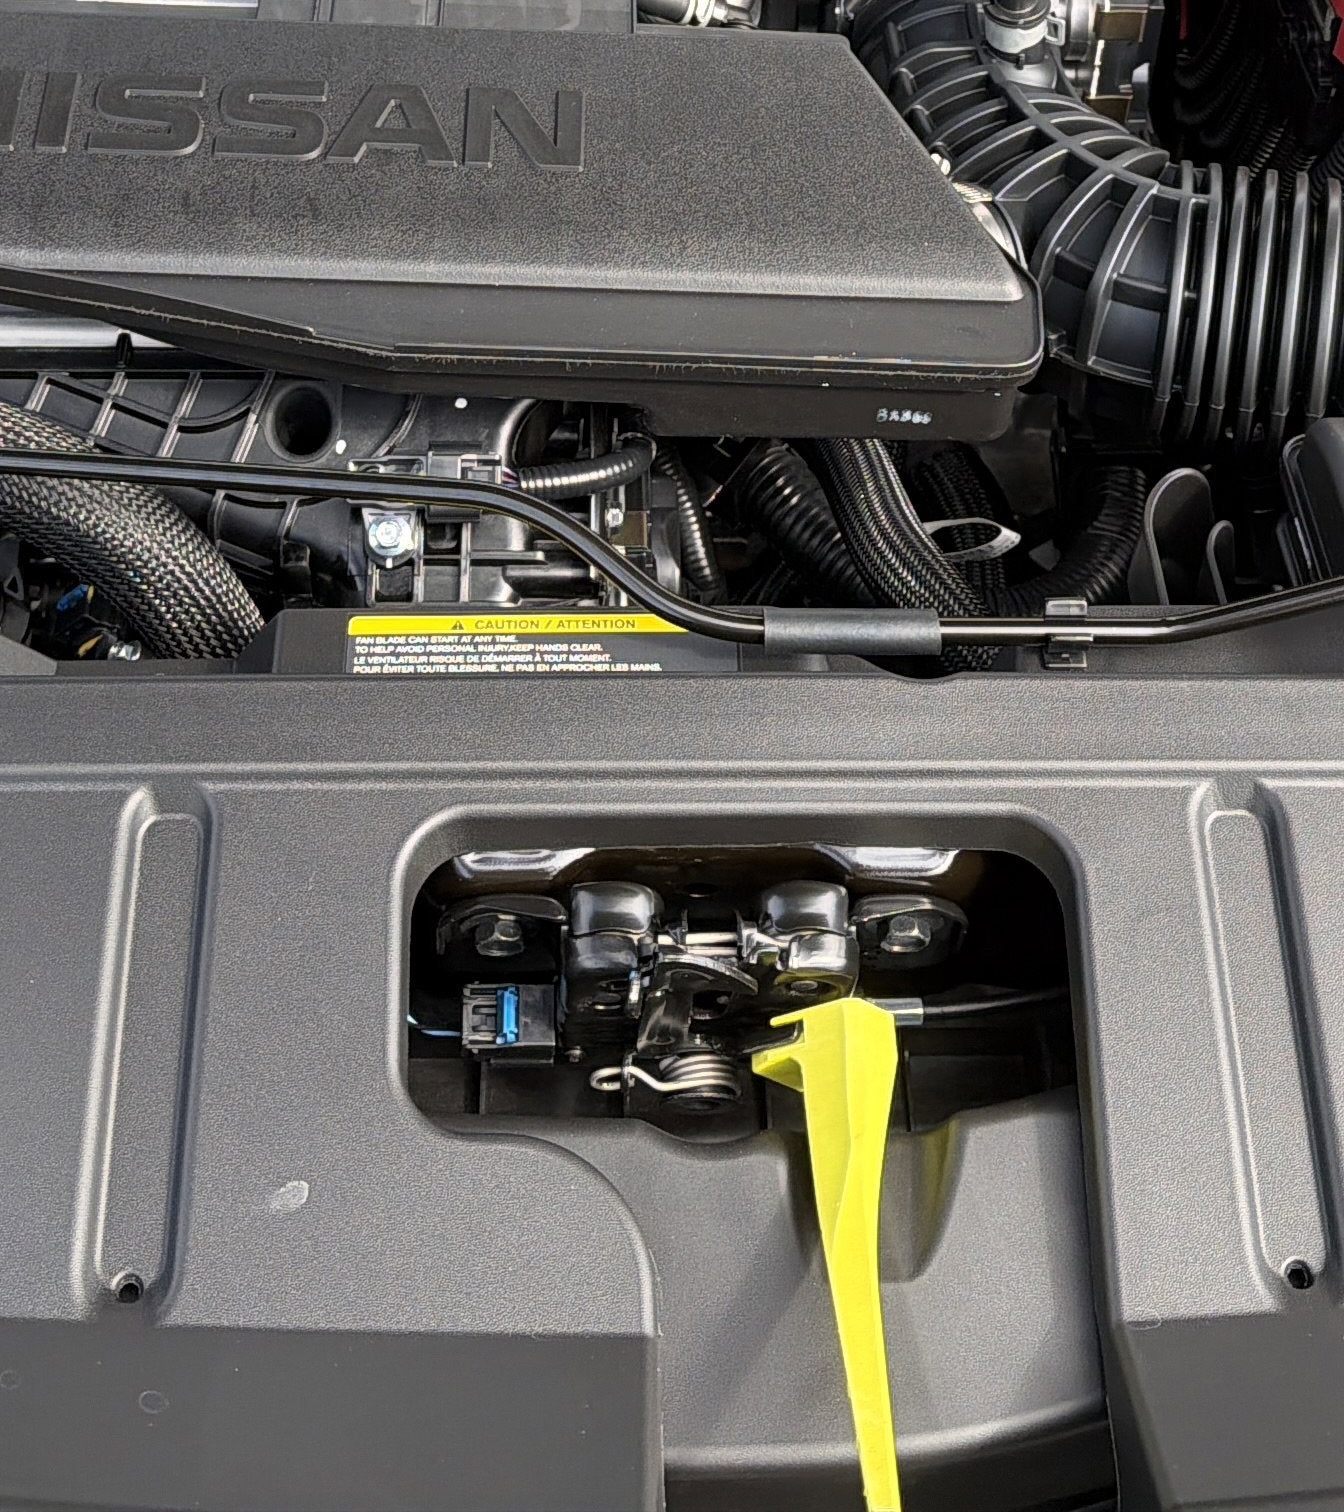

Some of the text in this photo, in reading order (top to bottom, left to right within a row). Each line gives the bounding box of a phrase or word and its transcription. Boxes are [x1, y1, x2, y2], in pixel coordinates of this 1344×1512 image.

[474, 619, 637, 630] CAUTION / ATTENTION
[355, 636, 375, 644] FAN
[375, 636, 407, 644] BLADE
[408, 636, 429, 644] CAN
[431, 636, 459, 644] START
[355, 646, 369, 654] TO
[370, 646, 395, 654] HELP
[396, 645, 424, 653] AVOID
[426, 645, 476, 653] PERSONAL
[536, 643, 568, 652] HANDS
[570, 643, 603, 652] CLEAR.
[354, 652, 612, 665] LE VENTILATEUR RISQUE DE DÉMARRER À TOUT MOMENT.
[353, 665, 381, 674] POUR
[383, 663, 415, 673] ÉVITER
[416, 665, 446, 673] TOUTE
[501, 664, 514, 672] NE
[516, 664, 535, 672] PAS
[536, 664, 550, 672] EN
[551, 664, 610, 672] APPROCHER
[611, 663, 629, 671] LES
[630, 663, 663, 672] MAINS.
